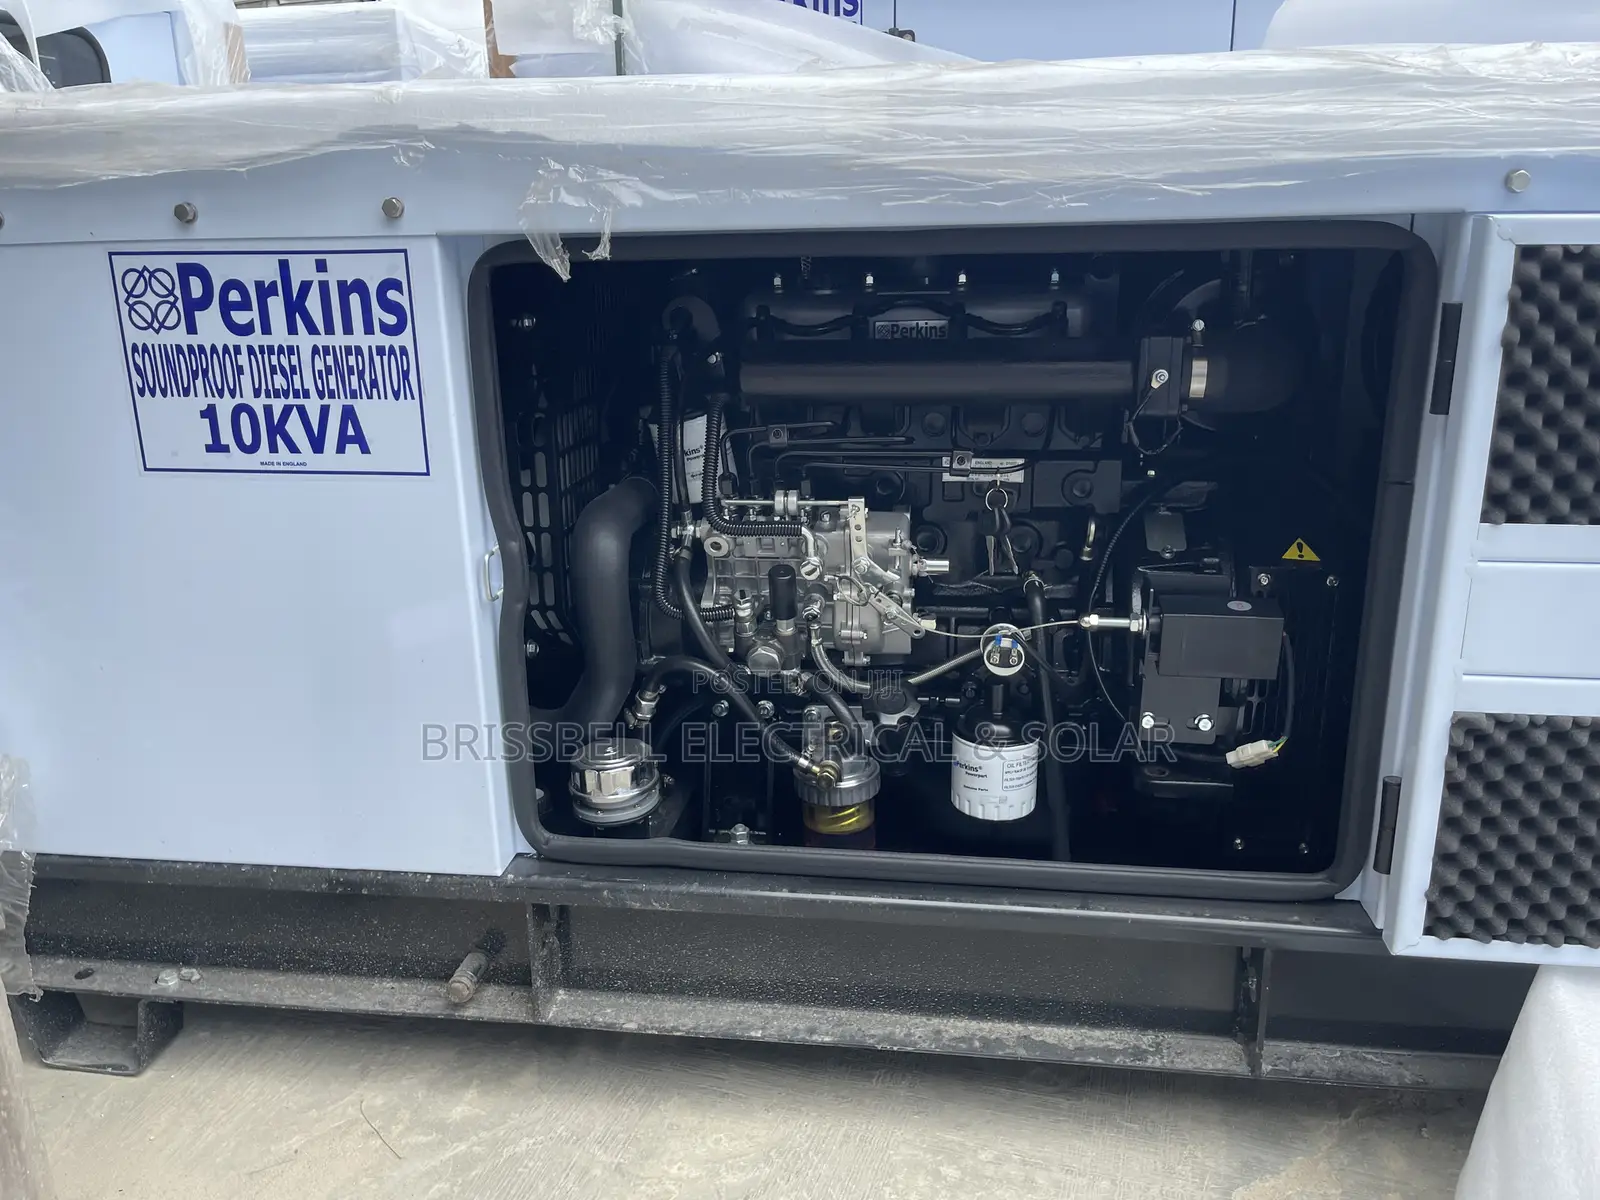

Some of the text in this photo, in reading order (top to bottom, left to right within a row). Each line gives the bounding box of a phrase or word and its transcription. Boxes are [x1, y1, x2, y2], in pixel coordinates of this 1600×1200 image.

[176, 258, 408, 337] Perkins
[891, 321, 947, 339] Perkins
[131, 342, 416, 401] SOUNDPROOF DIESEL GENERATOR
[199, 402, 372, 455] 10KVA
